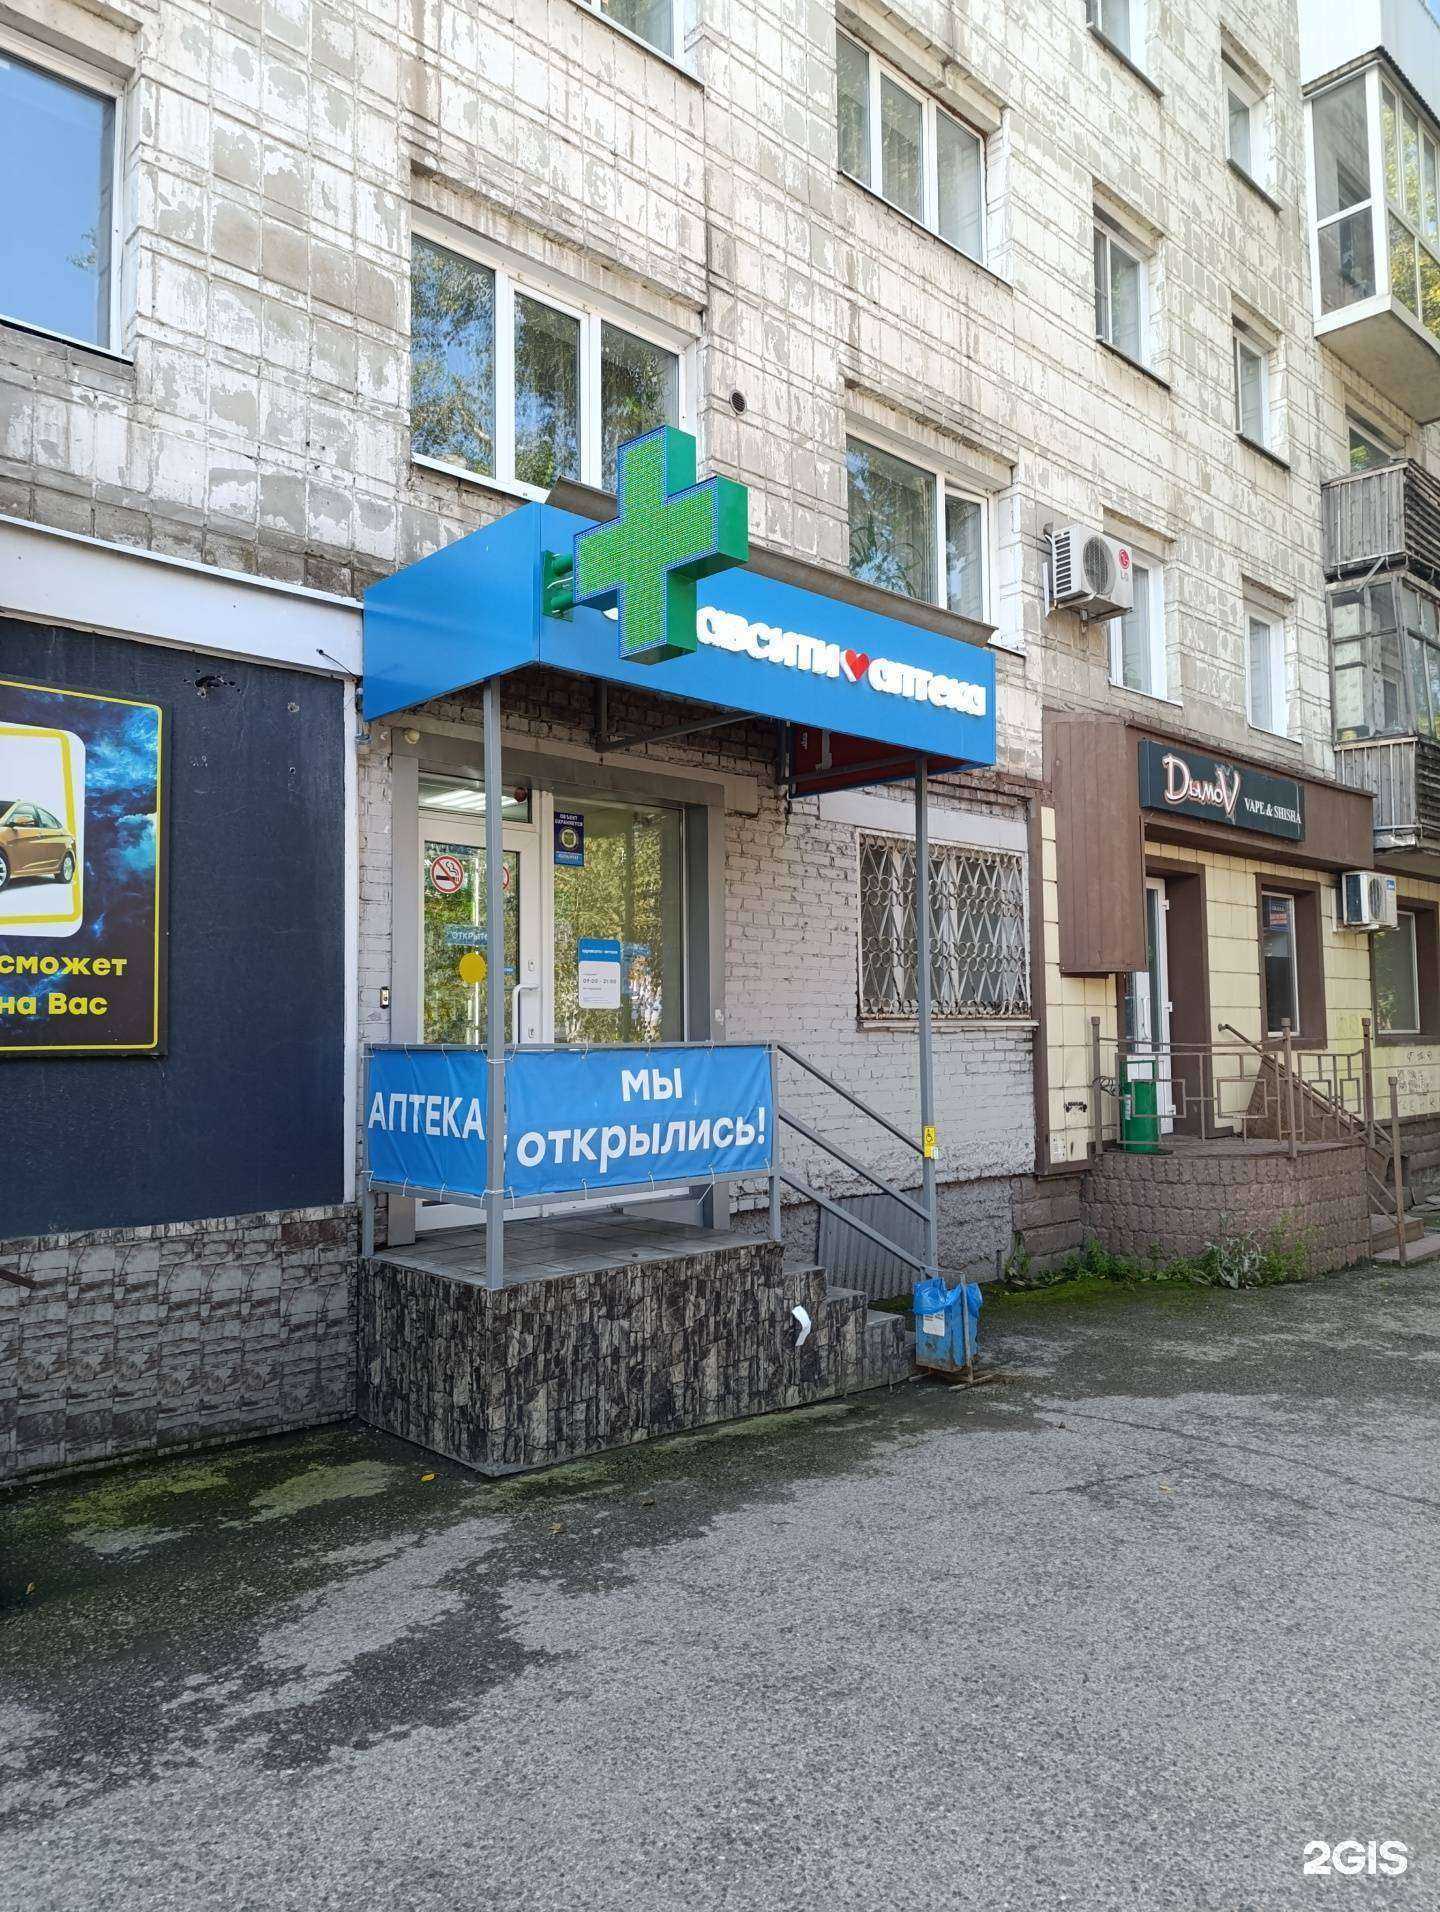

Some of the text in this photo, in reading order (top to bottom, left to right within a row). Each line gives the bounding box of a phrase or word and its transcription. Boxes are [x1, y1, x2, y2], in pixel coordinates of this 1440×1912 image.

[868, 658, 986, 716] аптека
[1244, 797, 1265, 816] VAPE
[1274, 806, 1301, 824] SHISHA
[0, 955, 127, 976] сможет
[48, 993, 108, 1015] Вас
[367, 1091, 486, 1140] АПТЕКА
[516, 1106, 767, 1173] открылись!
